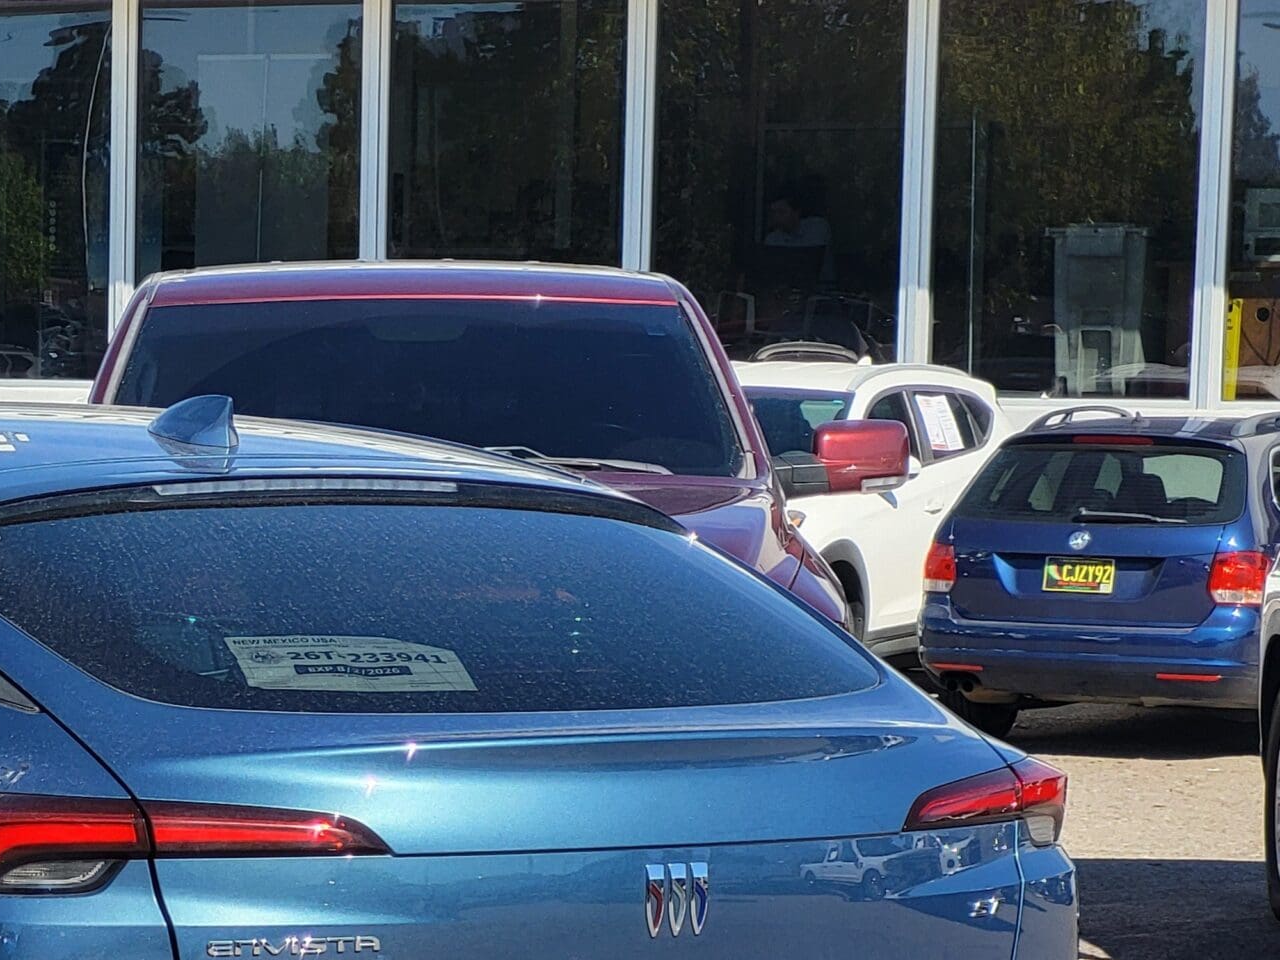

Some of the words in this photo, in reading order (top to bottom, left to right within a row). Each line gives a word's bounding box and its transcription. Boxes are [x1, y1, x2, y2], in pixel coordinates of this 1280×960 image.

[1062, 564, 1111, 583] CJZY92
[263, 636, 309, 645] MEXICO
[311, 636, 338, 644] USA
[286, 650, 448, 665] 26T-233941
[207, 934, 381, 957] ENVISTA
